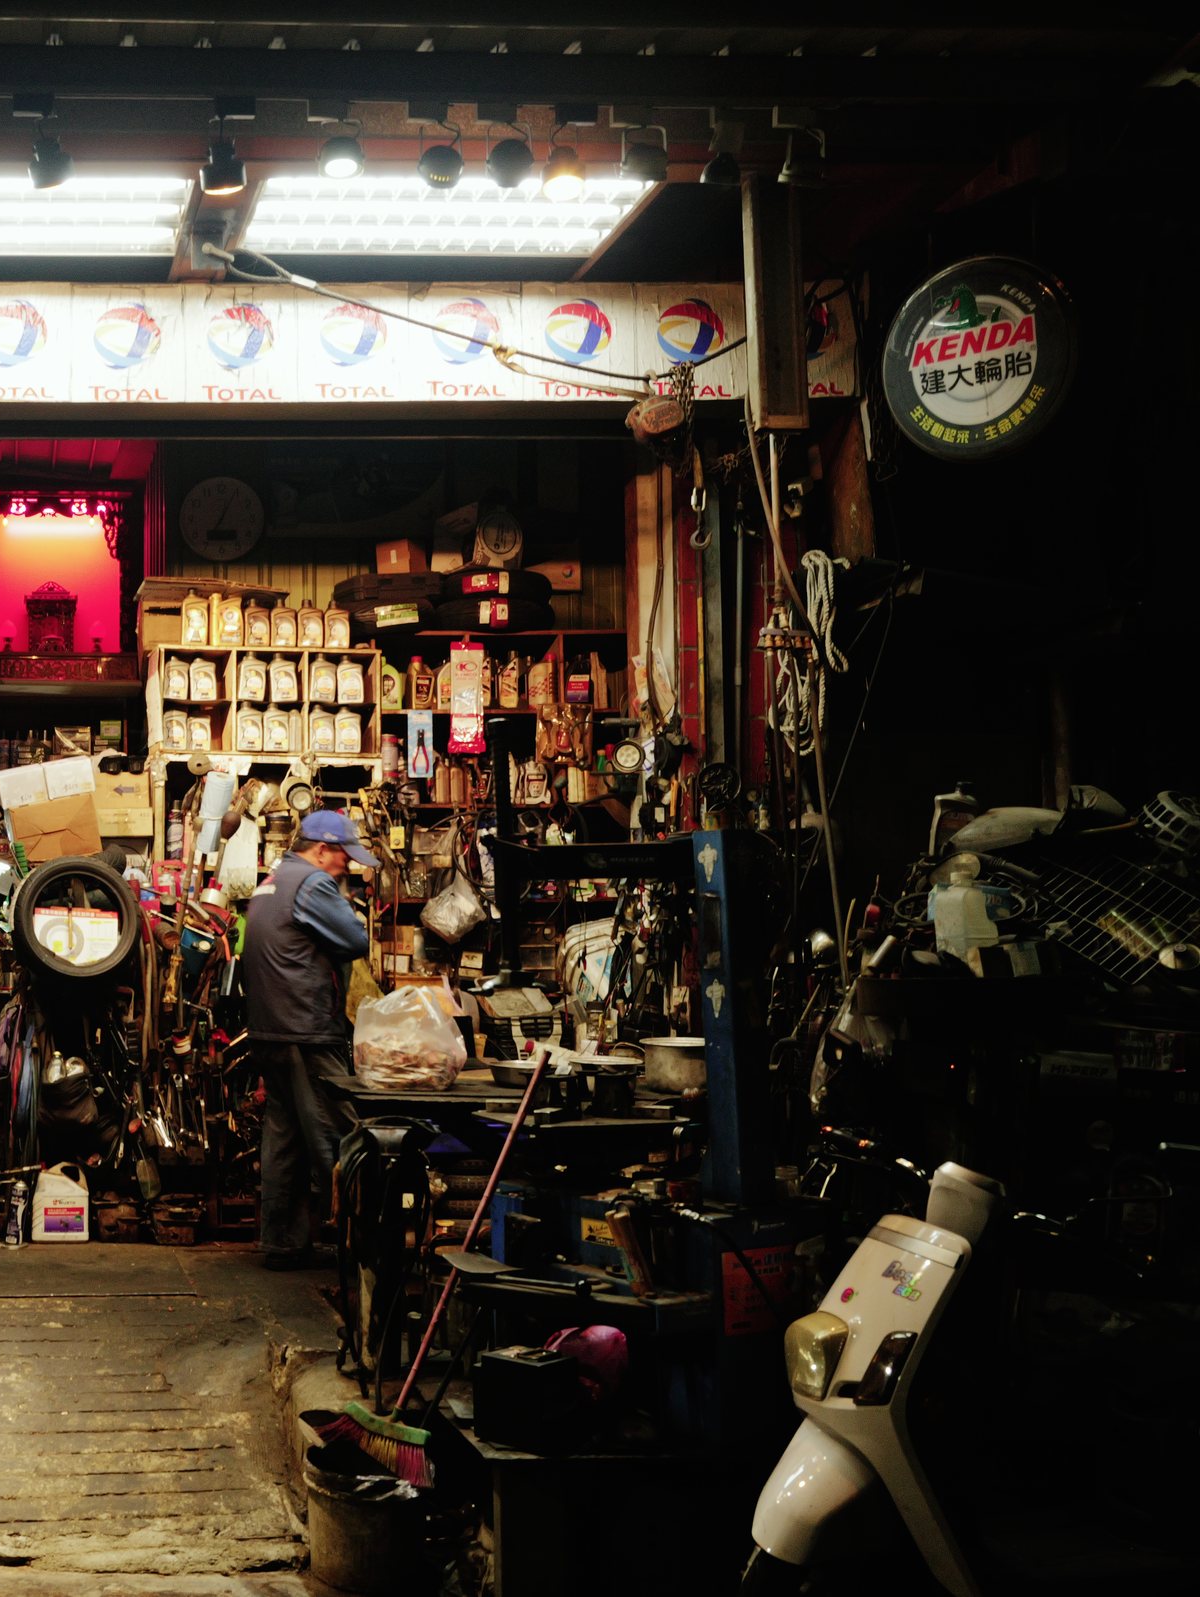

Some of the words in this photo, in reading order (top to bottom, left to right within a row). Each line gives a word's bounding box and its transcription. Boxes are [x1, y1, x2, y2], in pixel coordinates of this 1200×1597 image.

[1000, 283, 1038, 314] KENDA
[912, 315, 1035, 367] KENDA
[919, 350, 1033, 397] 建大輪胎
[89, 385, 168, 401] TOTAL
[202, 385, 281, 401] TOTAL
[316, 383, 395, 399] TOTAL
[427, 380, 506, 397] TOTAL
